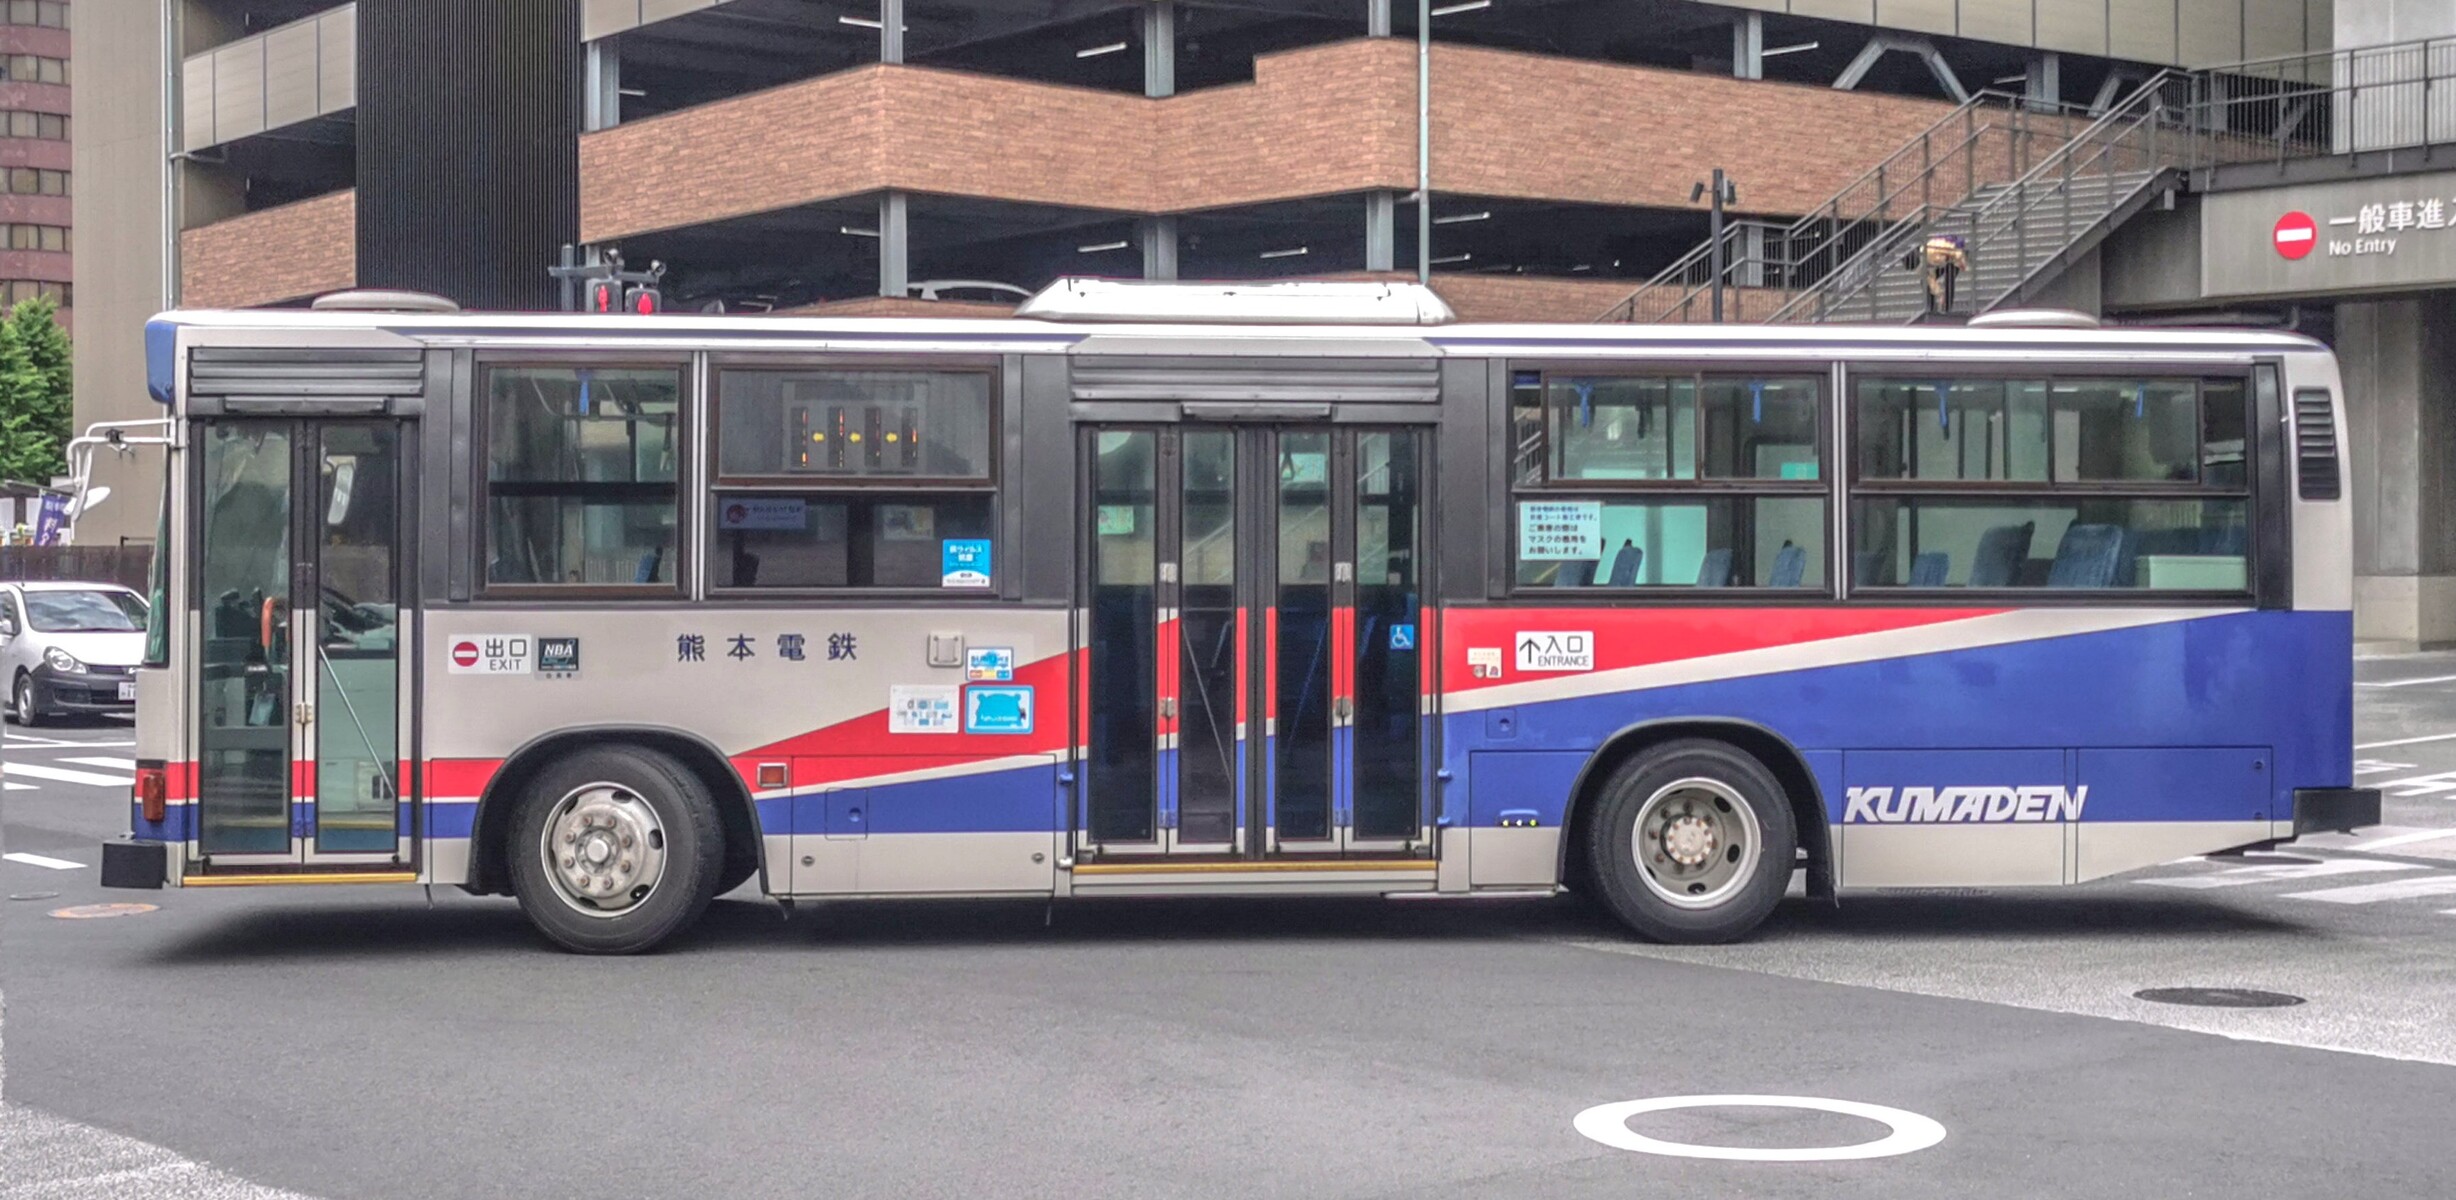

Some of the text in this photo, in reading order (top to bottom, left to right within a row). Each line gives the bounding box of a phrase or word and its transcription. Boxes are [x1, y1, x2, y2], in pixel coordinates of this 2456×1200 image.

[2328, 198, 2456, 234] 一般車進
[2329, 239, 2397, 256] No Entry
[485, 638, 527, 657] 出口
[544, 643, 574, 657] NBA
[677, 633, 857, 662] 熊本電鉄
[1545, 635, 1583, 654] 入口
[489, 659, 522, 670] EXIT
[1538, 655, 1588, 667] ENTRANCE
[1843, 785, 2088, 823] KUMADEN
